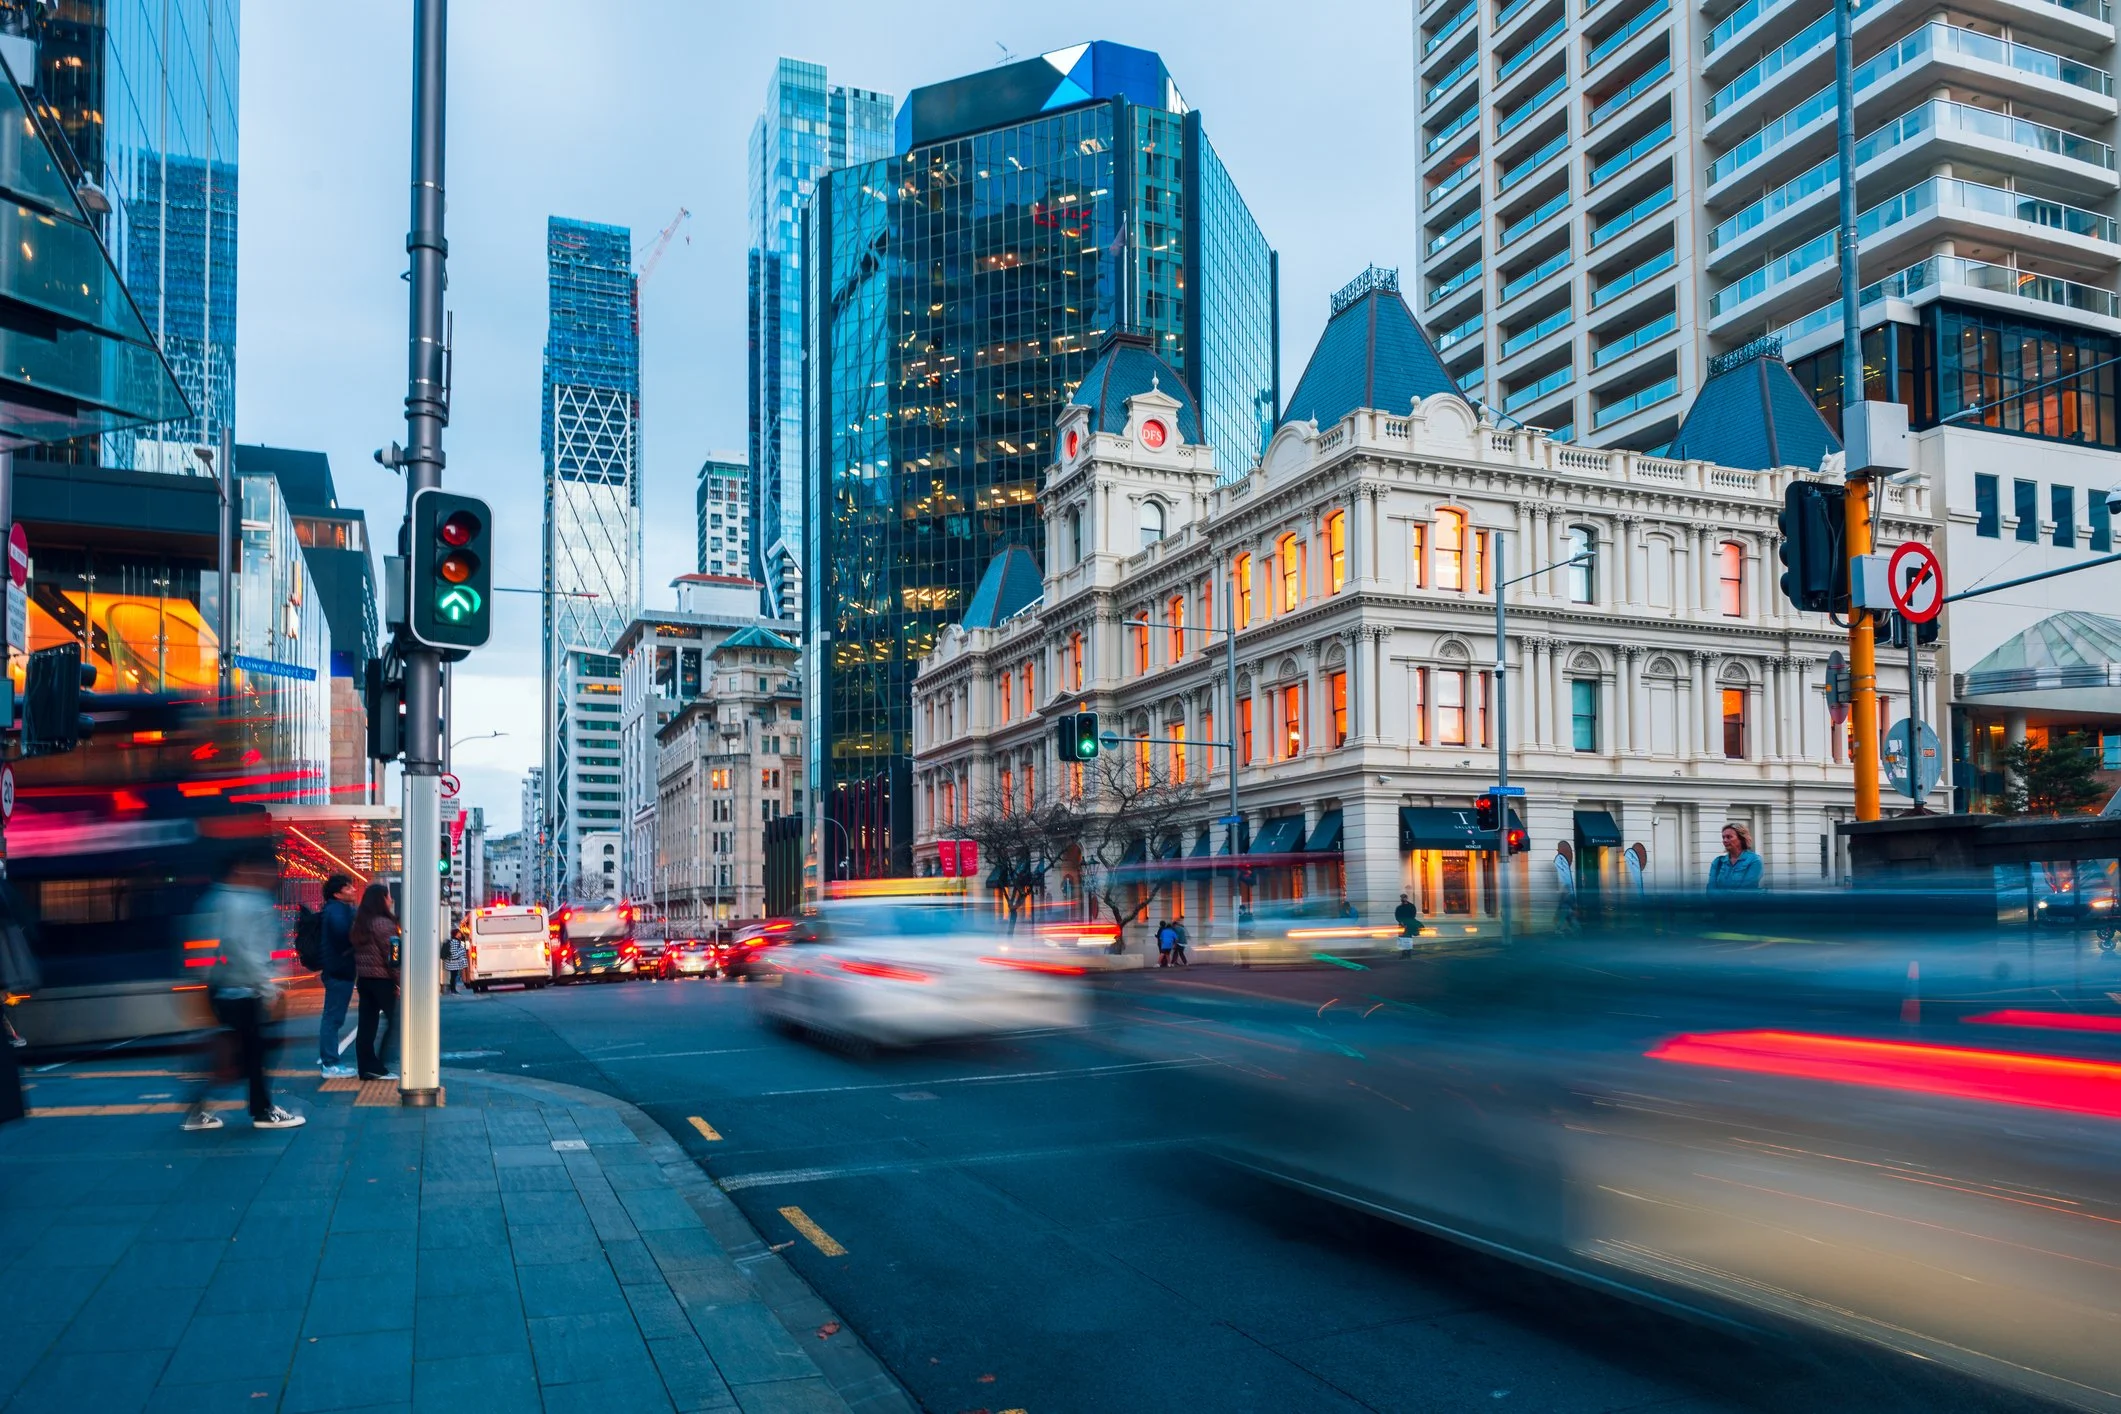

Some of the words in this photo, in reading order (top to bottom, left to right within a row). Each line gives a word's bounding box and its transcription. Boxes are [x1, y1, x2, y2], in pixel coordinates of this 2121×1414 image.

[1143, 429, 1162, 441] DFS
[240, 659, 268, 671] Lower
[271, 664, 299, 676] Albert
[302, 669, 312, 679] St
[4, 780, 12, 804] 20
[1452, 811, 1468, 825] T
